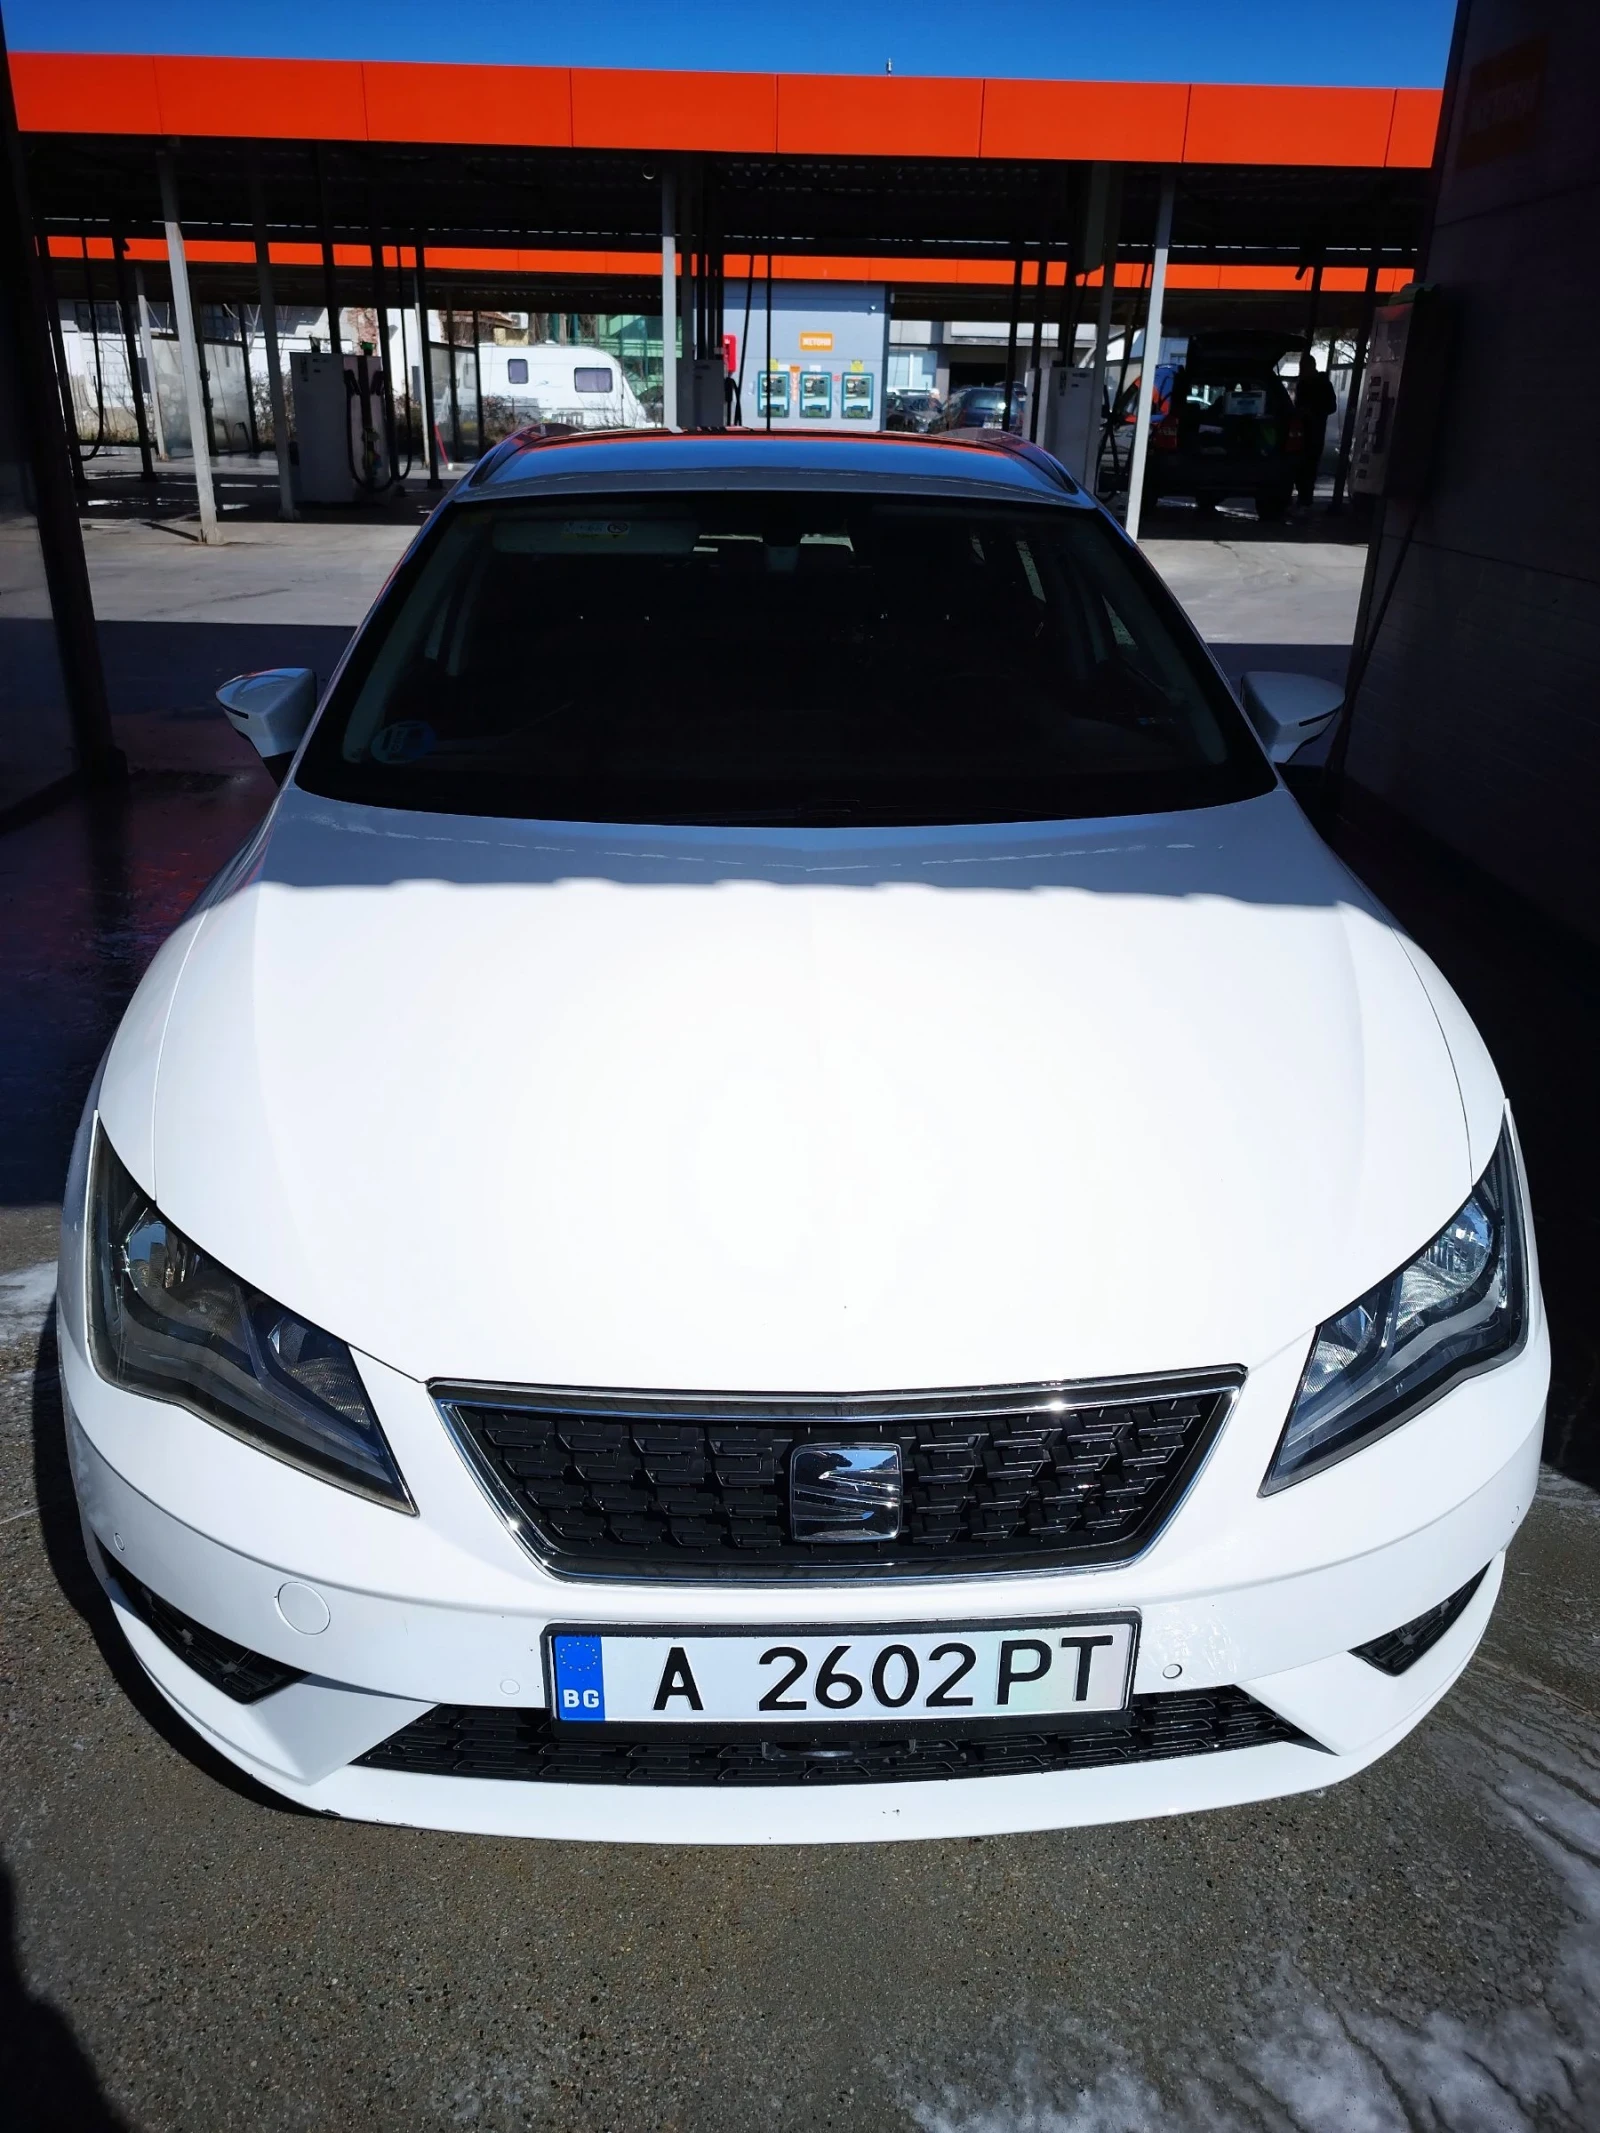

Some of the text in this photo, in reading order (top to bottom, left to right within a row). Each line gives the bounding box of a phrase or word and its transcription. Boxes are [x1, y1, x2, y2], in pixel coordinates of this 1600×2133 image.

[652, 1634, 1113, 1711] A 2602 PT
[563, 1688, 599, 1709] BG
